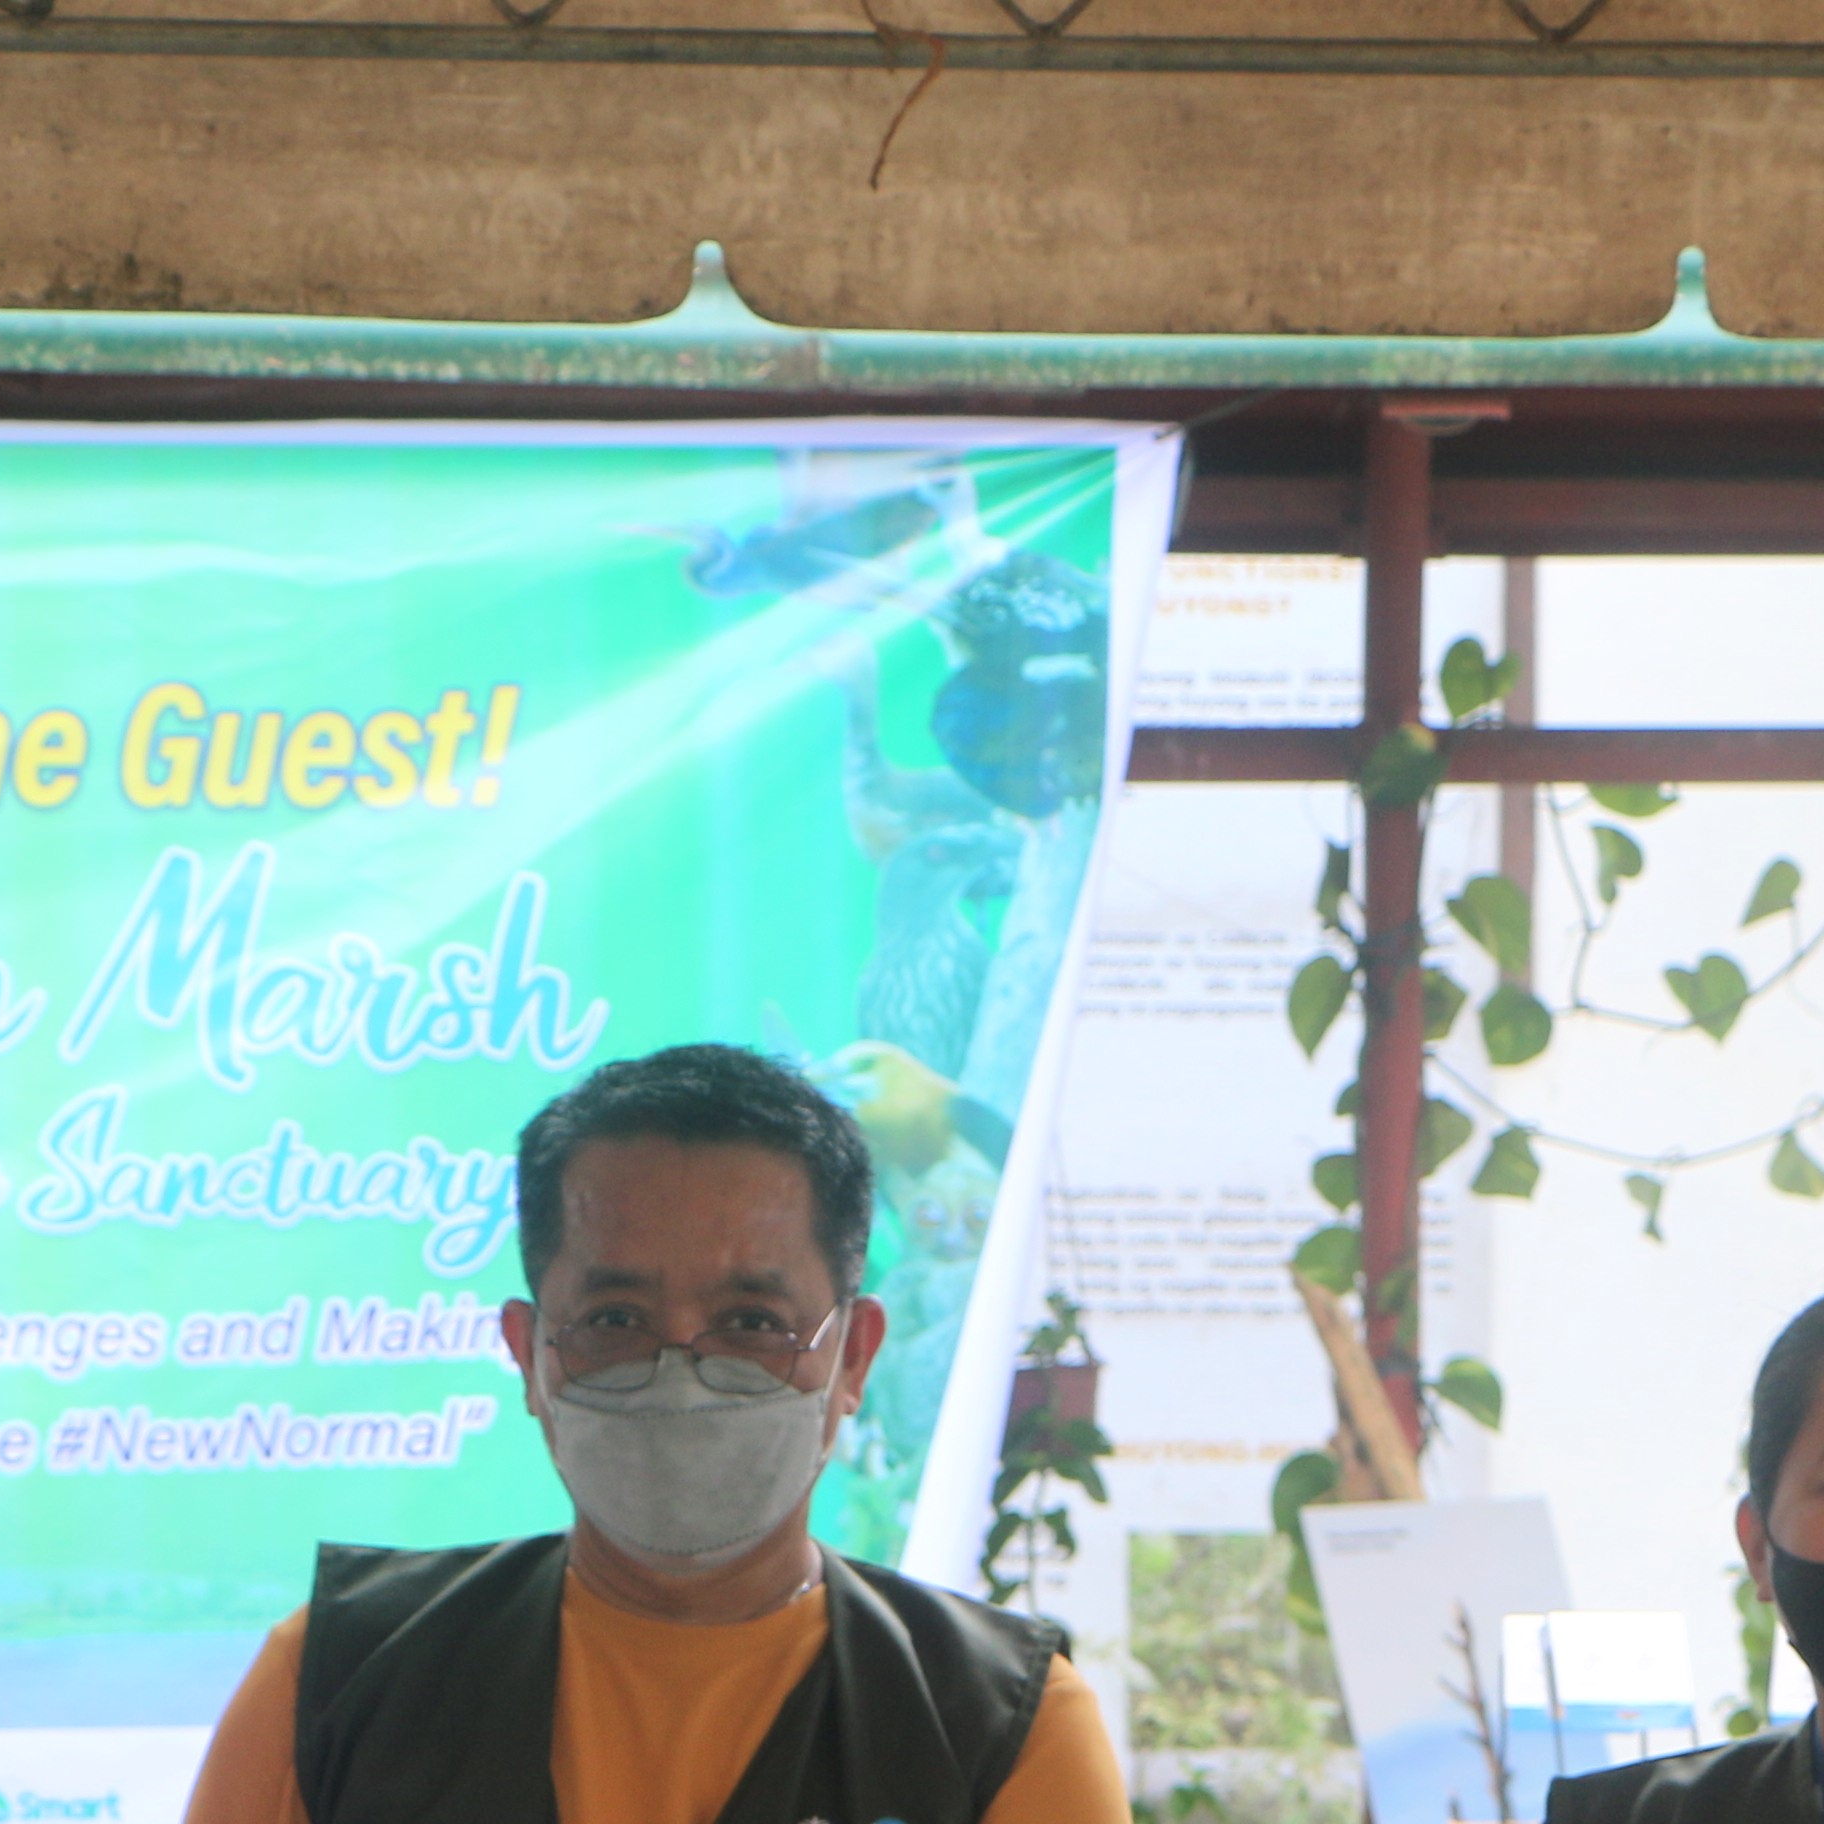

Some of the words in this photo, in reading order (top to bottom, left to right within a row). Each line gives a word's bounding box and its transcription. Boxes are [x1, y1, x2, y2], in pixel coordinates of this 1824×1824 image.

[120, 680, 523, 810] Guest!
[58, 842, 606, 1090] Marsh
[22, 1086, 519, 1272] Sanctuary
[180, 1302, 299, 1358] and
[319, 1300, 514, 1370] Makin
[18, 1790, 123, 1823] Smart
